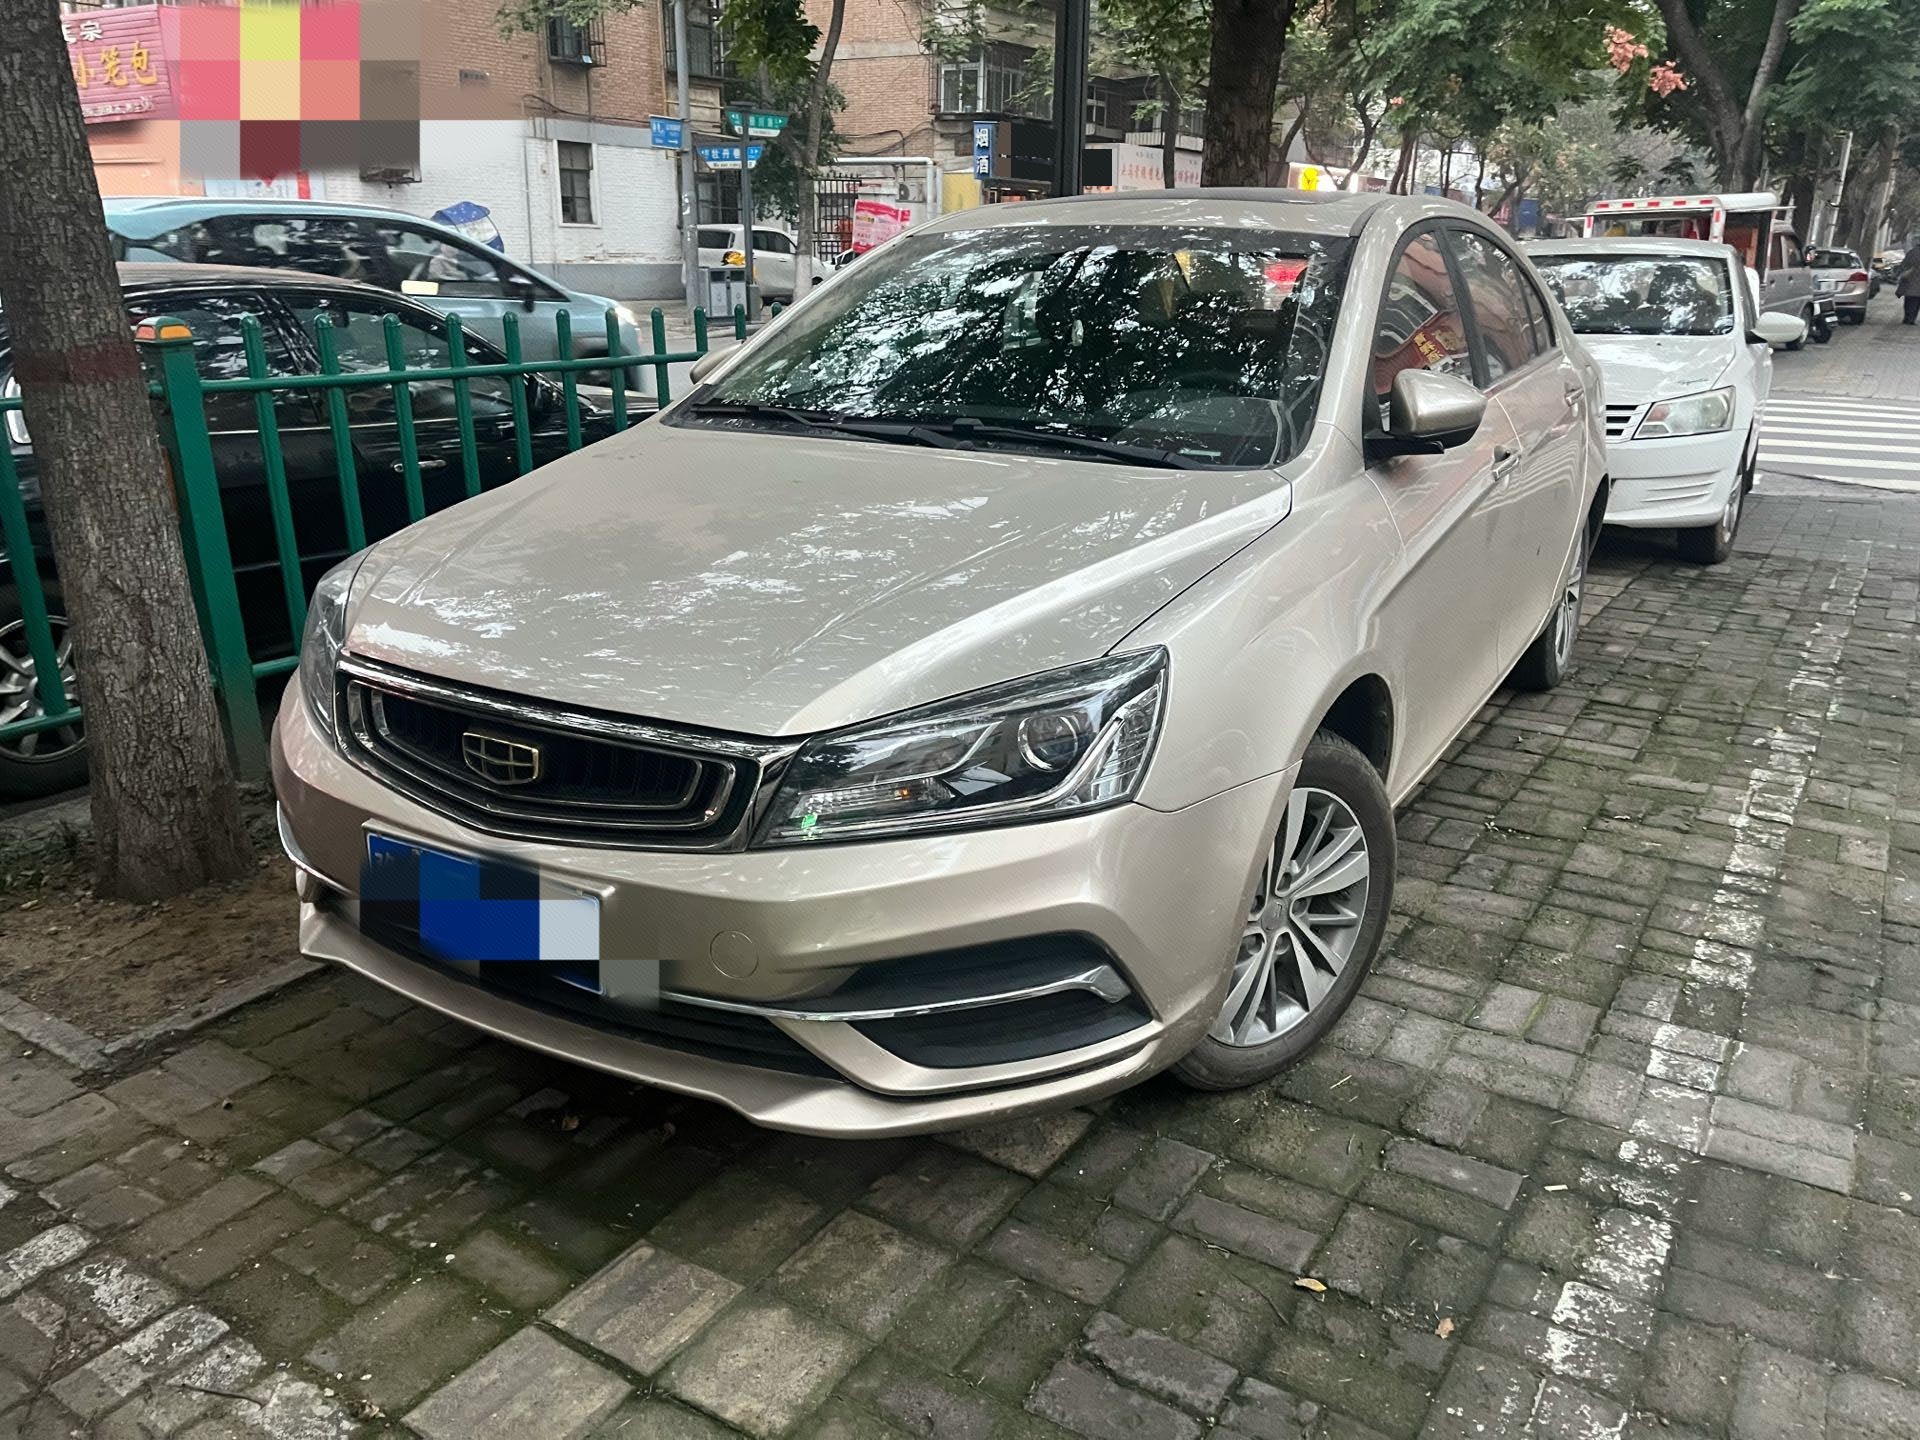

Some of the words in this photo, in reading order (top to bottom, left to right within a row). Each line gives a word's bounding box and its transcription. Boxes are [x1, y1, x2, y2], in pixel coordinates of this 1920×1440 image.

[74, 40, 158, 89] 小笼包
[975, 128, 989, 175] 烟酒
